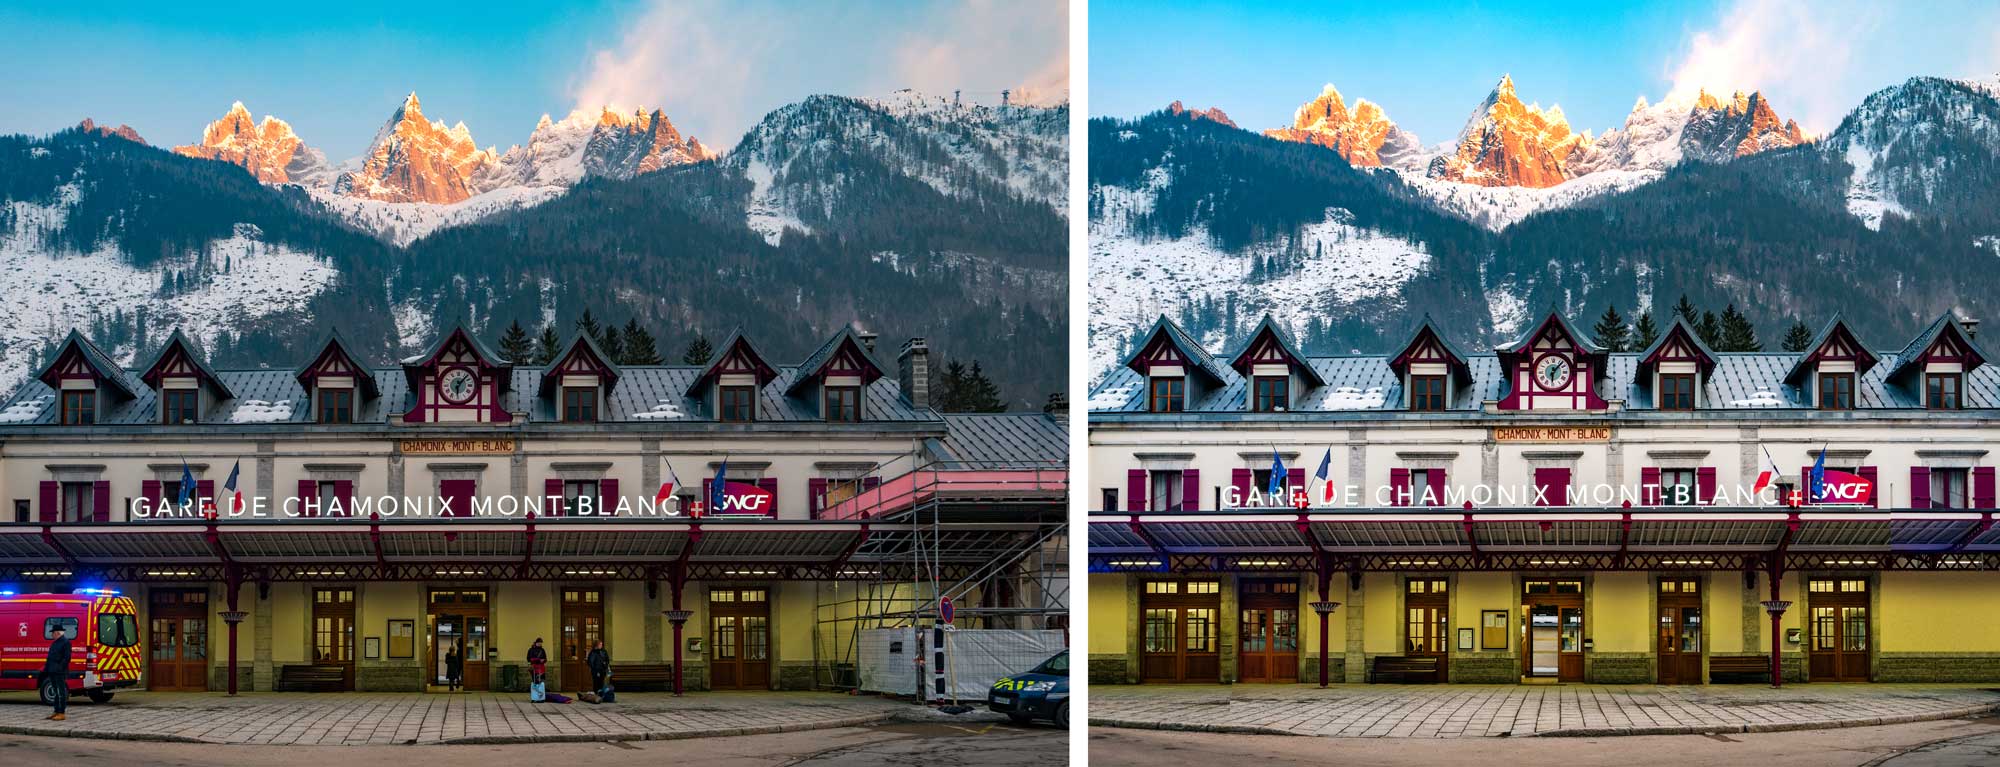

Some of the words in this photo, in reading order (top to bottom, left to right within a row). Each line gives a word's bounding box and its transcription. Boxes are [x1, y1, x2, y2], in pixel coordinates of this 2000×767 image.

[1497, 428, 1541, 440] CHAMONIX
[1547, 428, 1572, 440] MONT
[1577, 428, 1608, 440] BLANC
[403, 441, 446, 452] CHAMONIX
[452, 441, 476, 452] MONT
[482, 441, 512, 452] BLANC
[1222, 485, 1304, 507] GARE
[1319, 485, 1360, 507] DE
[1375, 484, 1550, 506] CHAMONIX
[1565, 483, 1780, 506] MONT-BLANC
[132, 496, 213, 518] GARE
[228, 496, 268, 517] DE
[283, 495, 455, 518] CHAMONIX
[470, 494, 681, 517] MONT-BLANC
